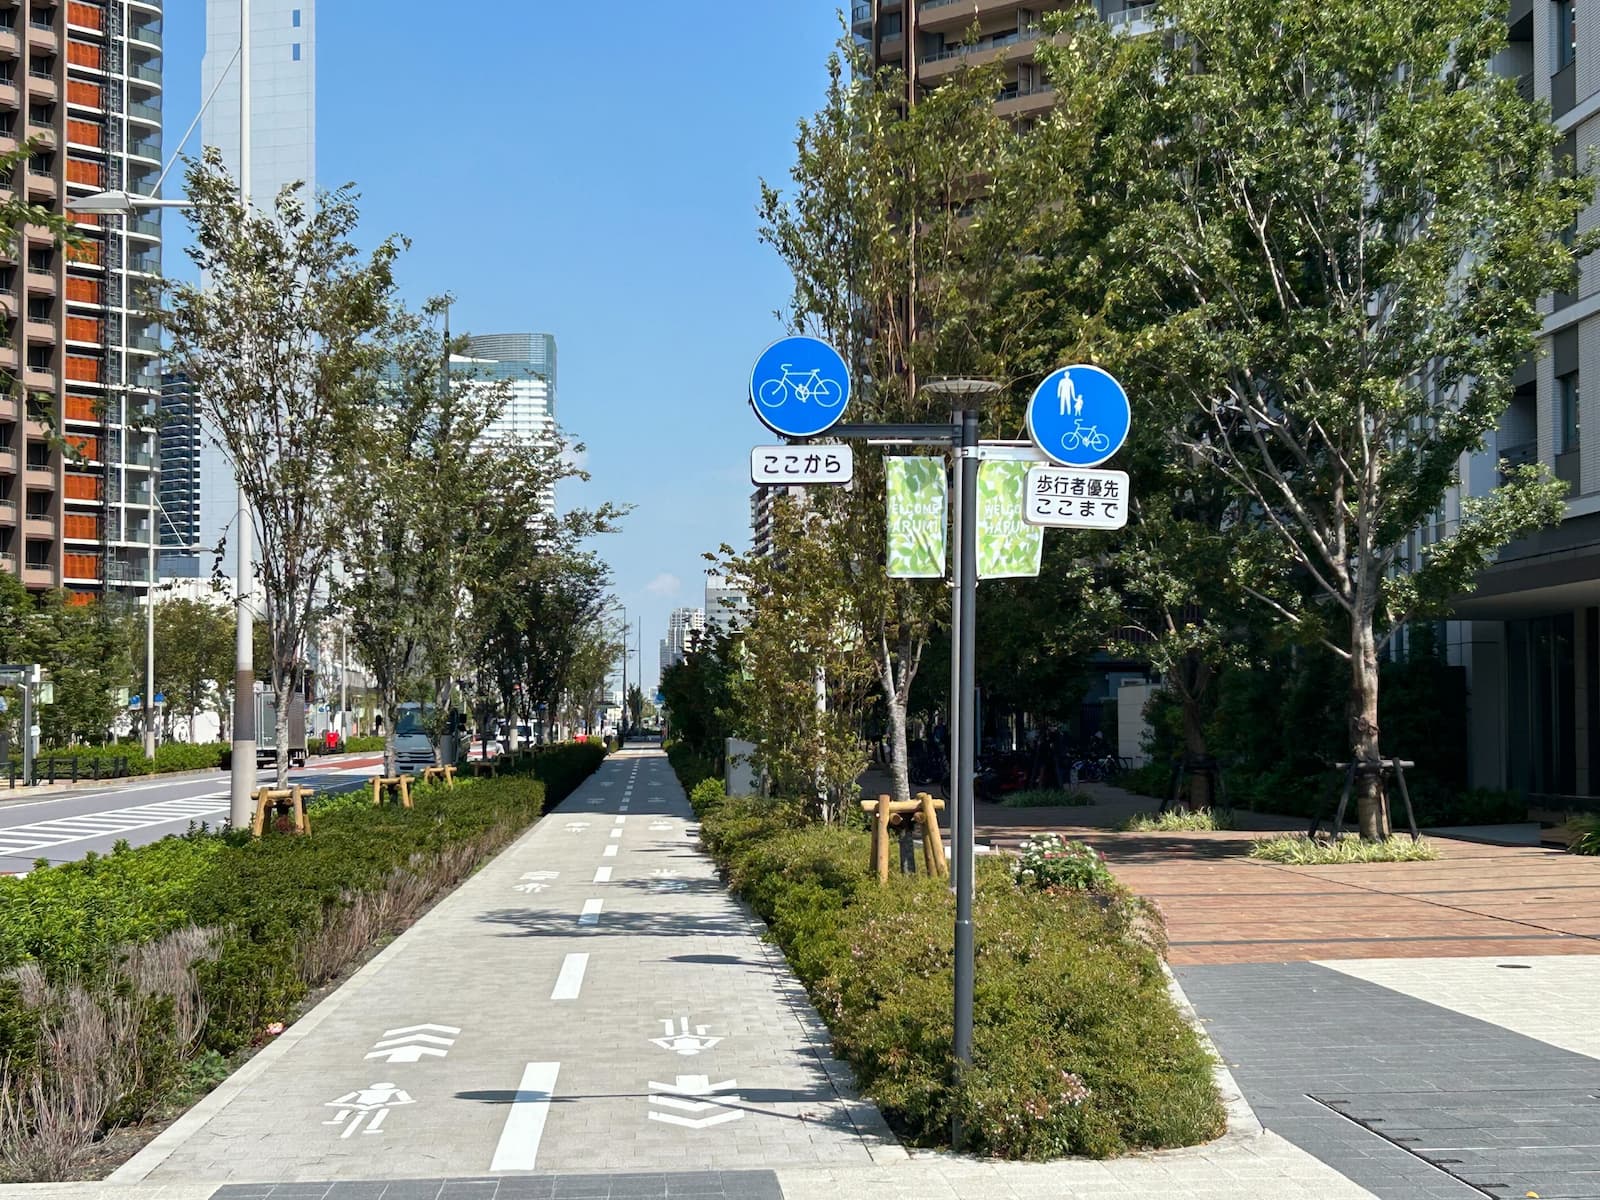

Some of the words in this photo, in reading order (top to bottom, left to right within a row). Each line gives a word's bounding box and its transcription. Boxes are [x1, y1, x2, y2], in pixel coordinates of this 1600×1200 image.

[764, 453, 841, 475] ここから
[1036, 474, 1119, 496] 歩行者優先
[890, 503, 939, 515] ELCOME
[984, 503, 1023, 514] WELCO
[1036, 498, 1119, 519] ここまで
[890, 518, 938, 533] ARUMI
